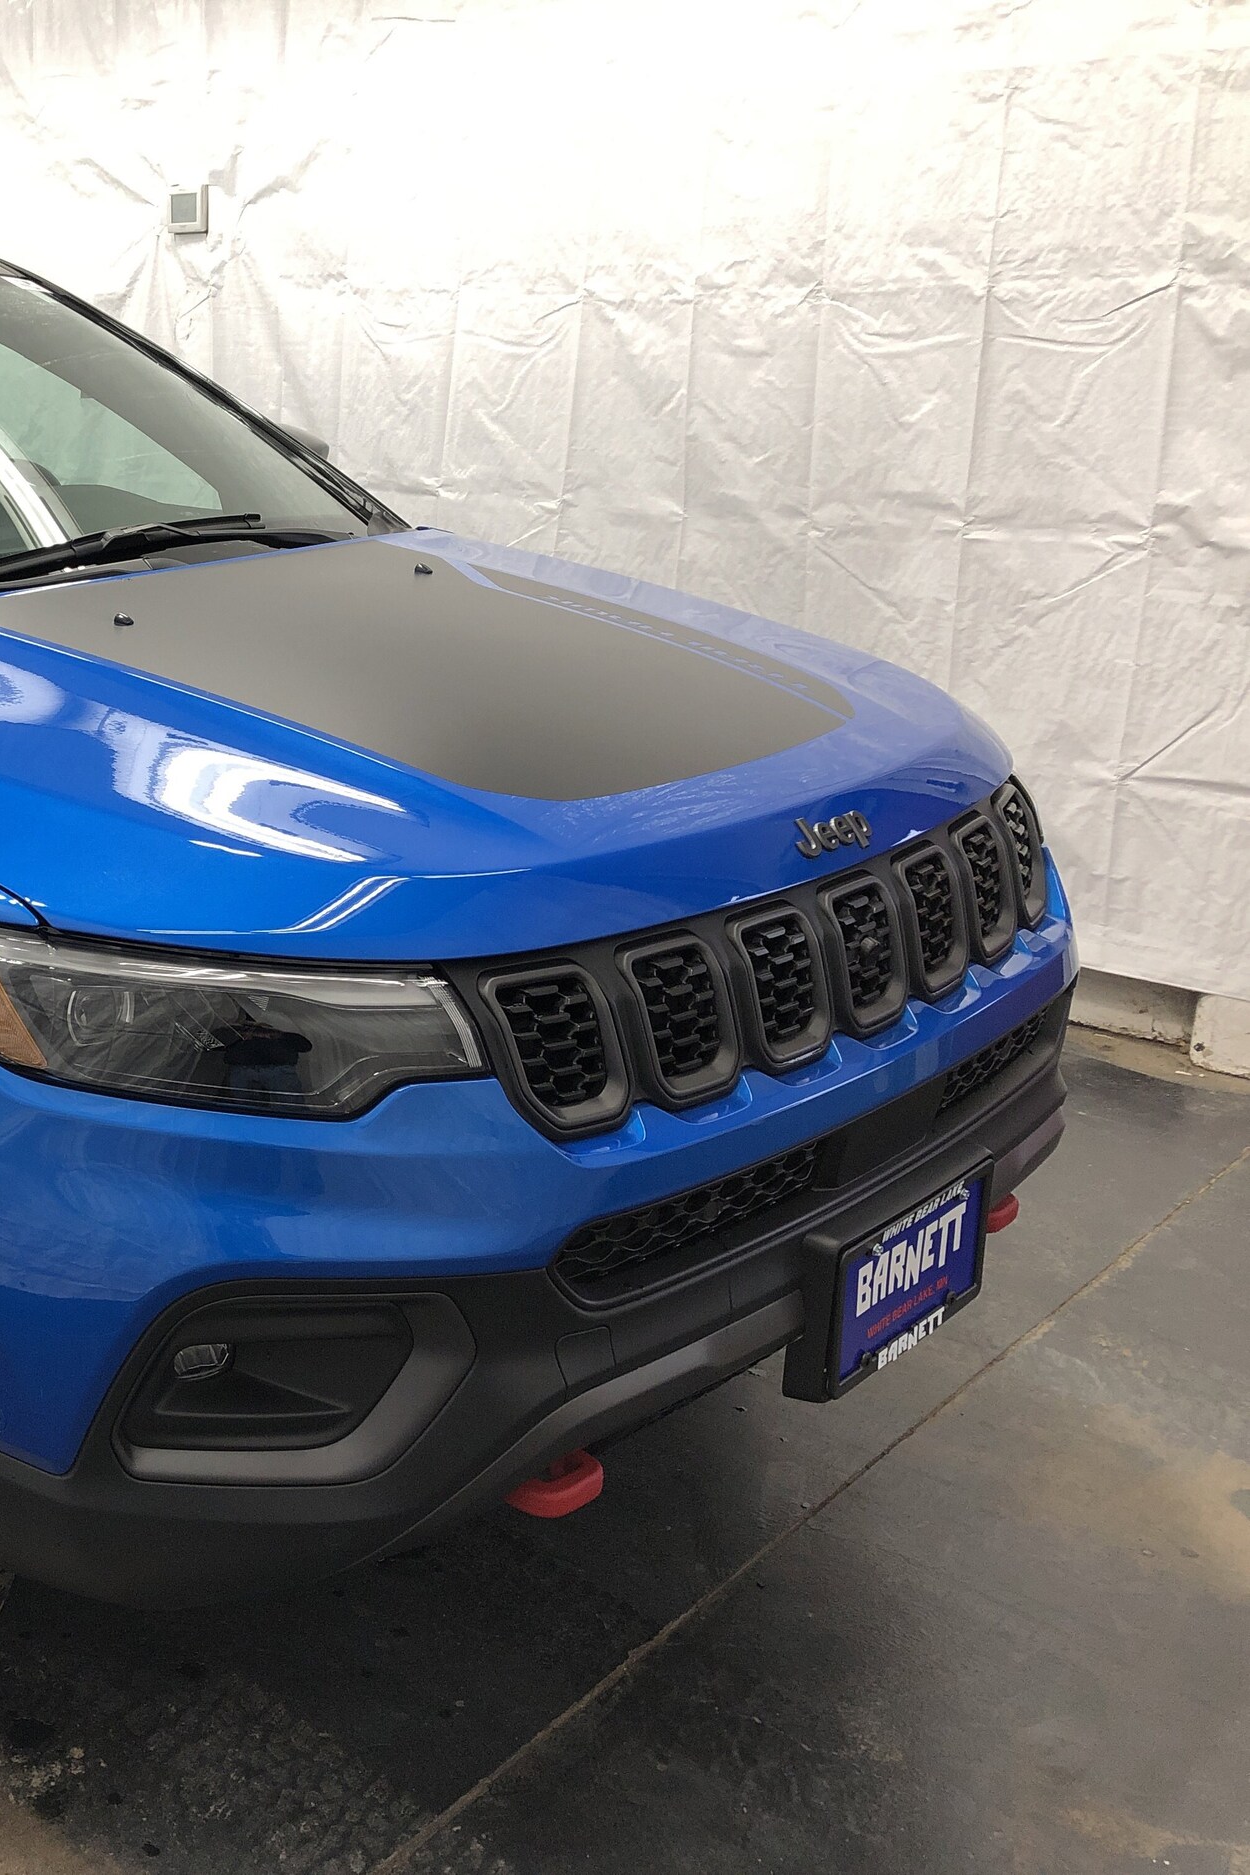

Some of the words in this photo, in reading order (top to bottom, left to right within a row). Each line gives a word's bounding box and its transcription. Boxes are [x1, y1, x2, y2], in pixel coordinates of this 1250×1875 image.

[794, 810, 872, 858] Jeep
[881, 1213, 915, 1243] WHITE
[914, 1198, 941, 1223] BEAR
[939, 1180, 965, 1206] LAKE
[856, 1201, 967, 1318] BARNETT
[866, 1316, 892, 1339] WHITE
[892, 1299, 912, 1321] BEAR
[877, 1305, 945, 1370] BARNETT
